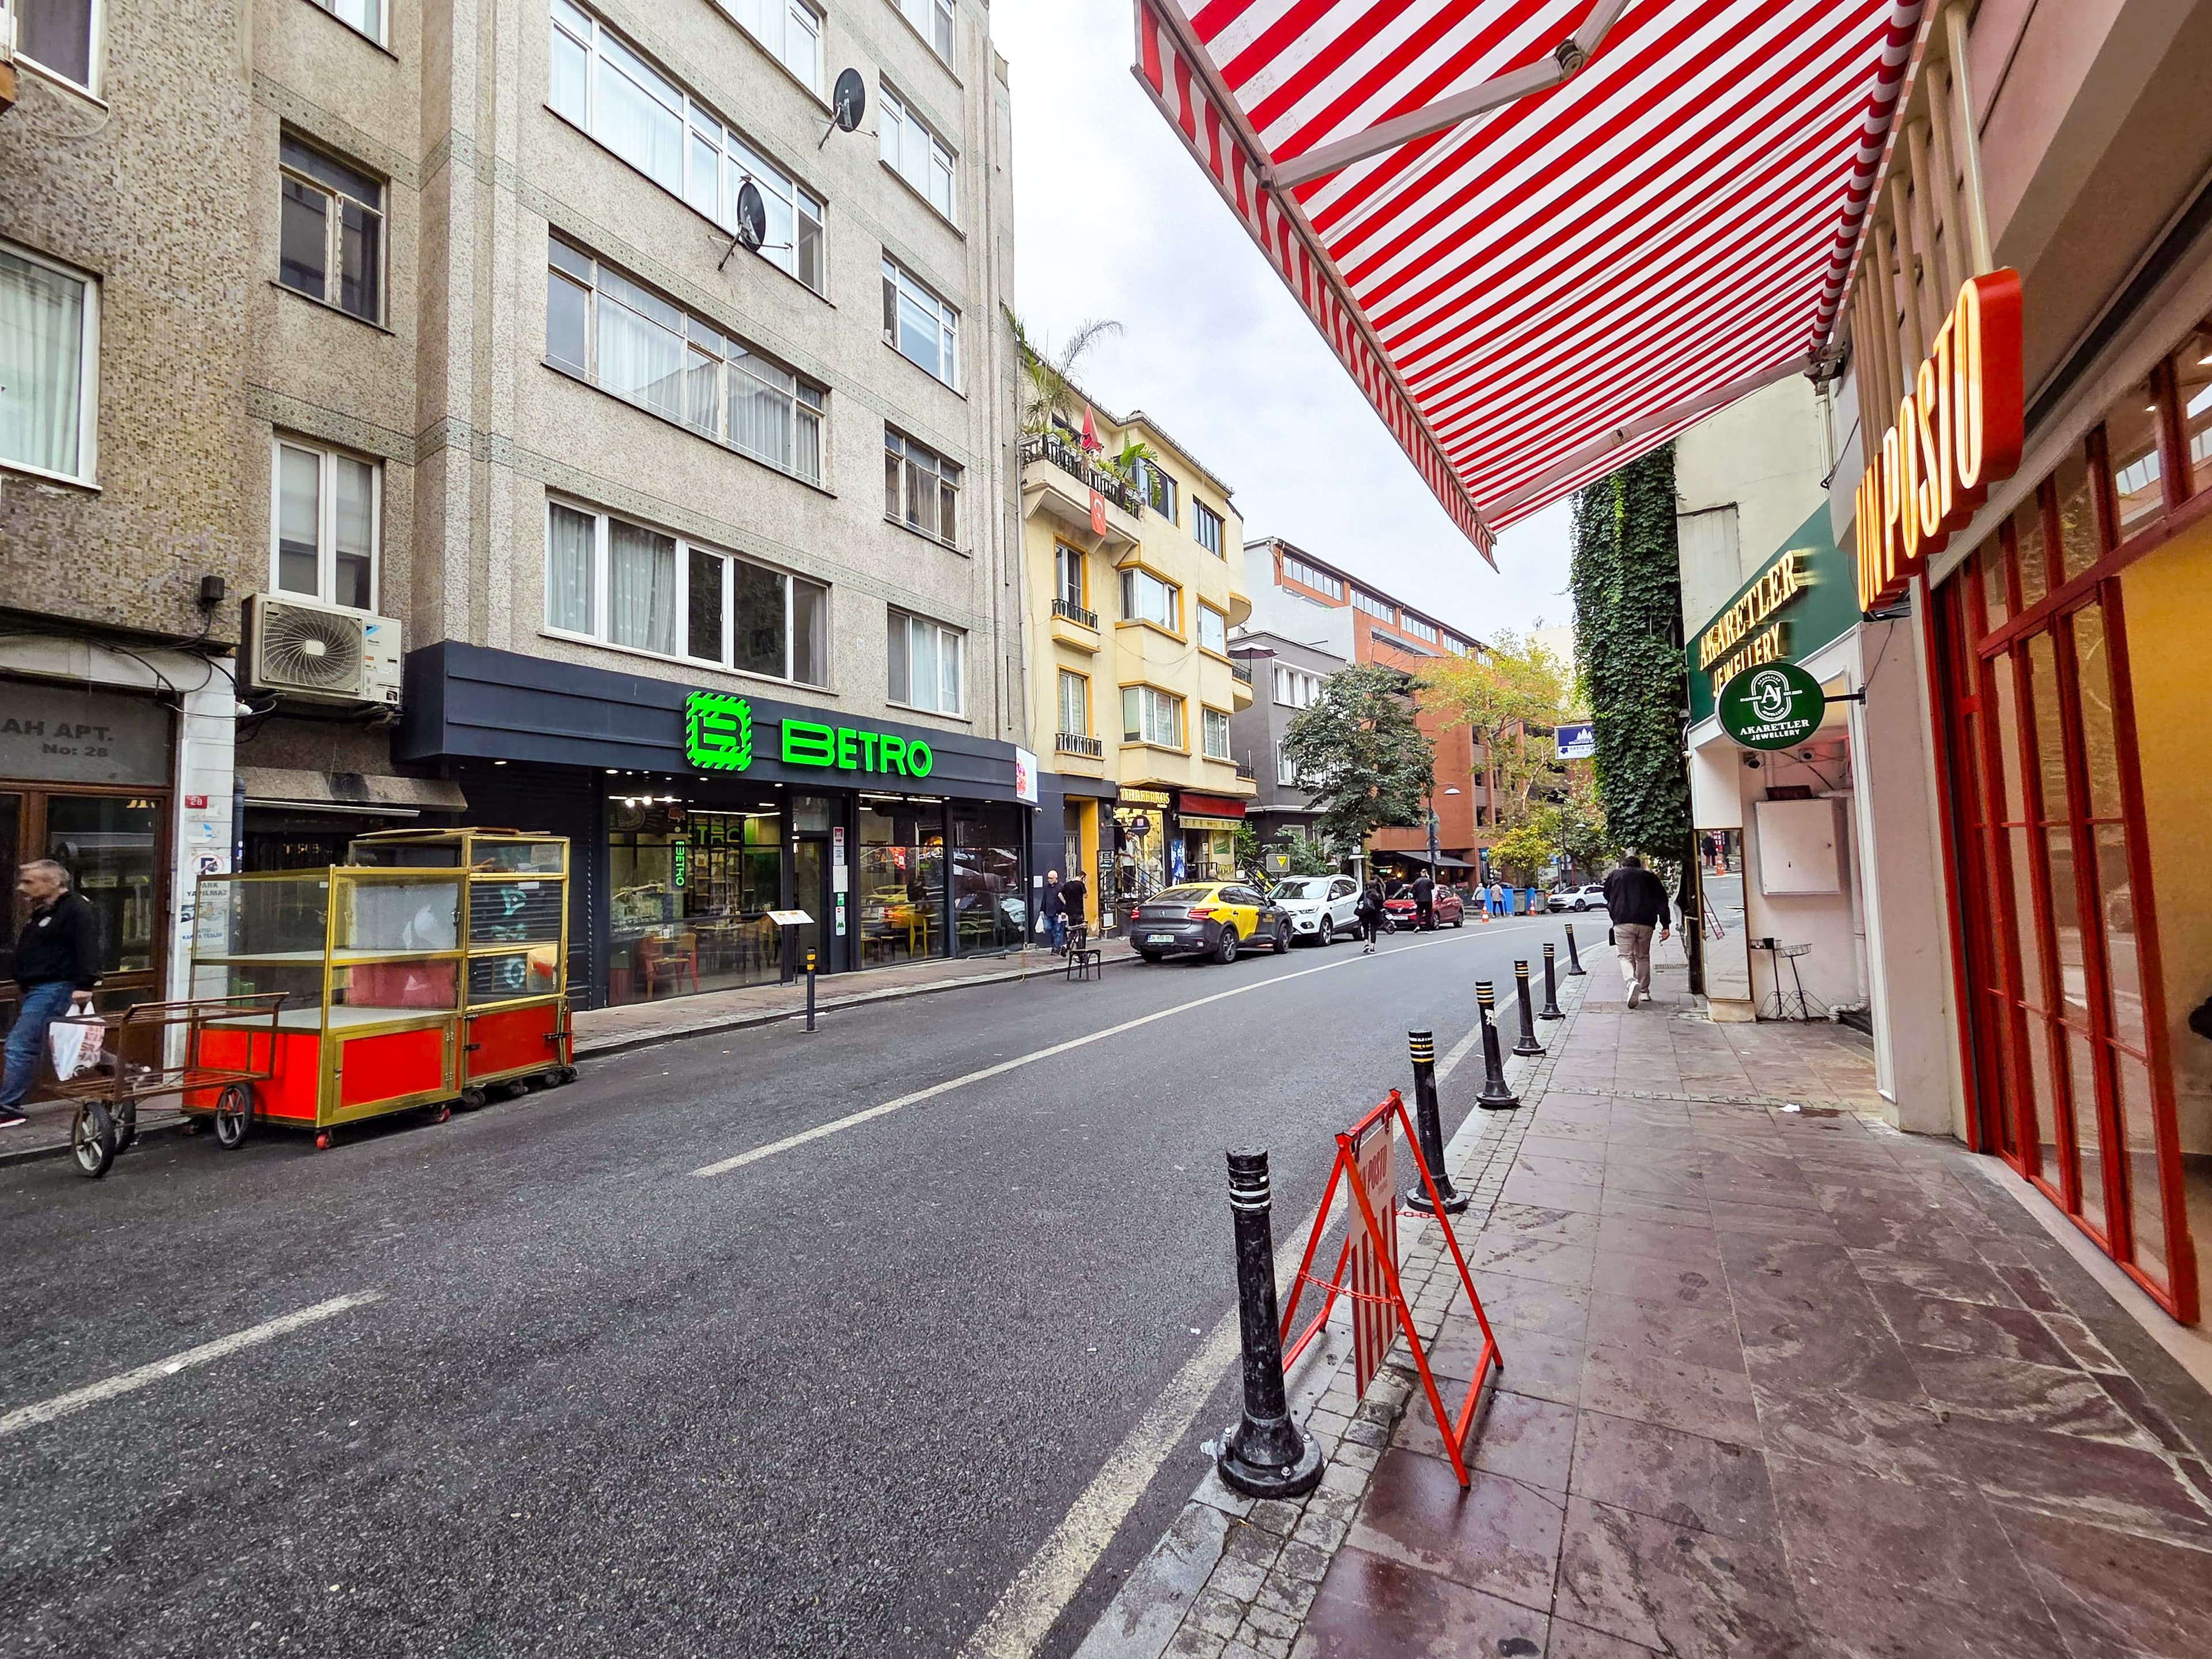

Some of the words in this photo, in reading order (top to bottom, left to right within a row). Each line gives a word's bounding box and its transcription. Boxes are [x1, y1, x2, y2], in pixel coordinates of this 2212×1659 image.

[1883, 278, 1982, 582] POSTO
[1700, 550, 1798, 671] AKARETLER
[54, 723, 113, 741] APT.
[1740, 719, 1809, 735] AKARETLER
[1751, 729, 1800, 741] JEWELLERY
[41, 743, 77, 755] No:
[85, 747, 108, 757] 28
[781, 718, 933, 778] BETRO
[675, 840, 685, 887] BETRO
